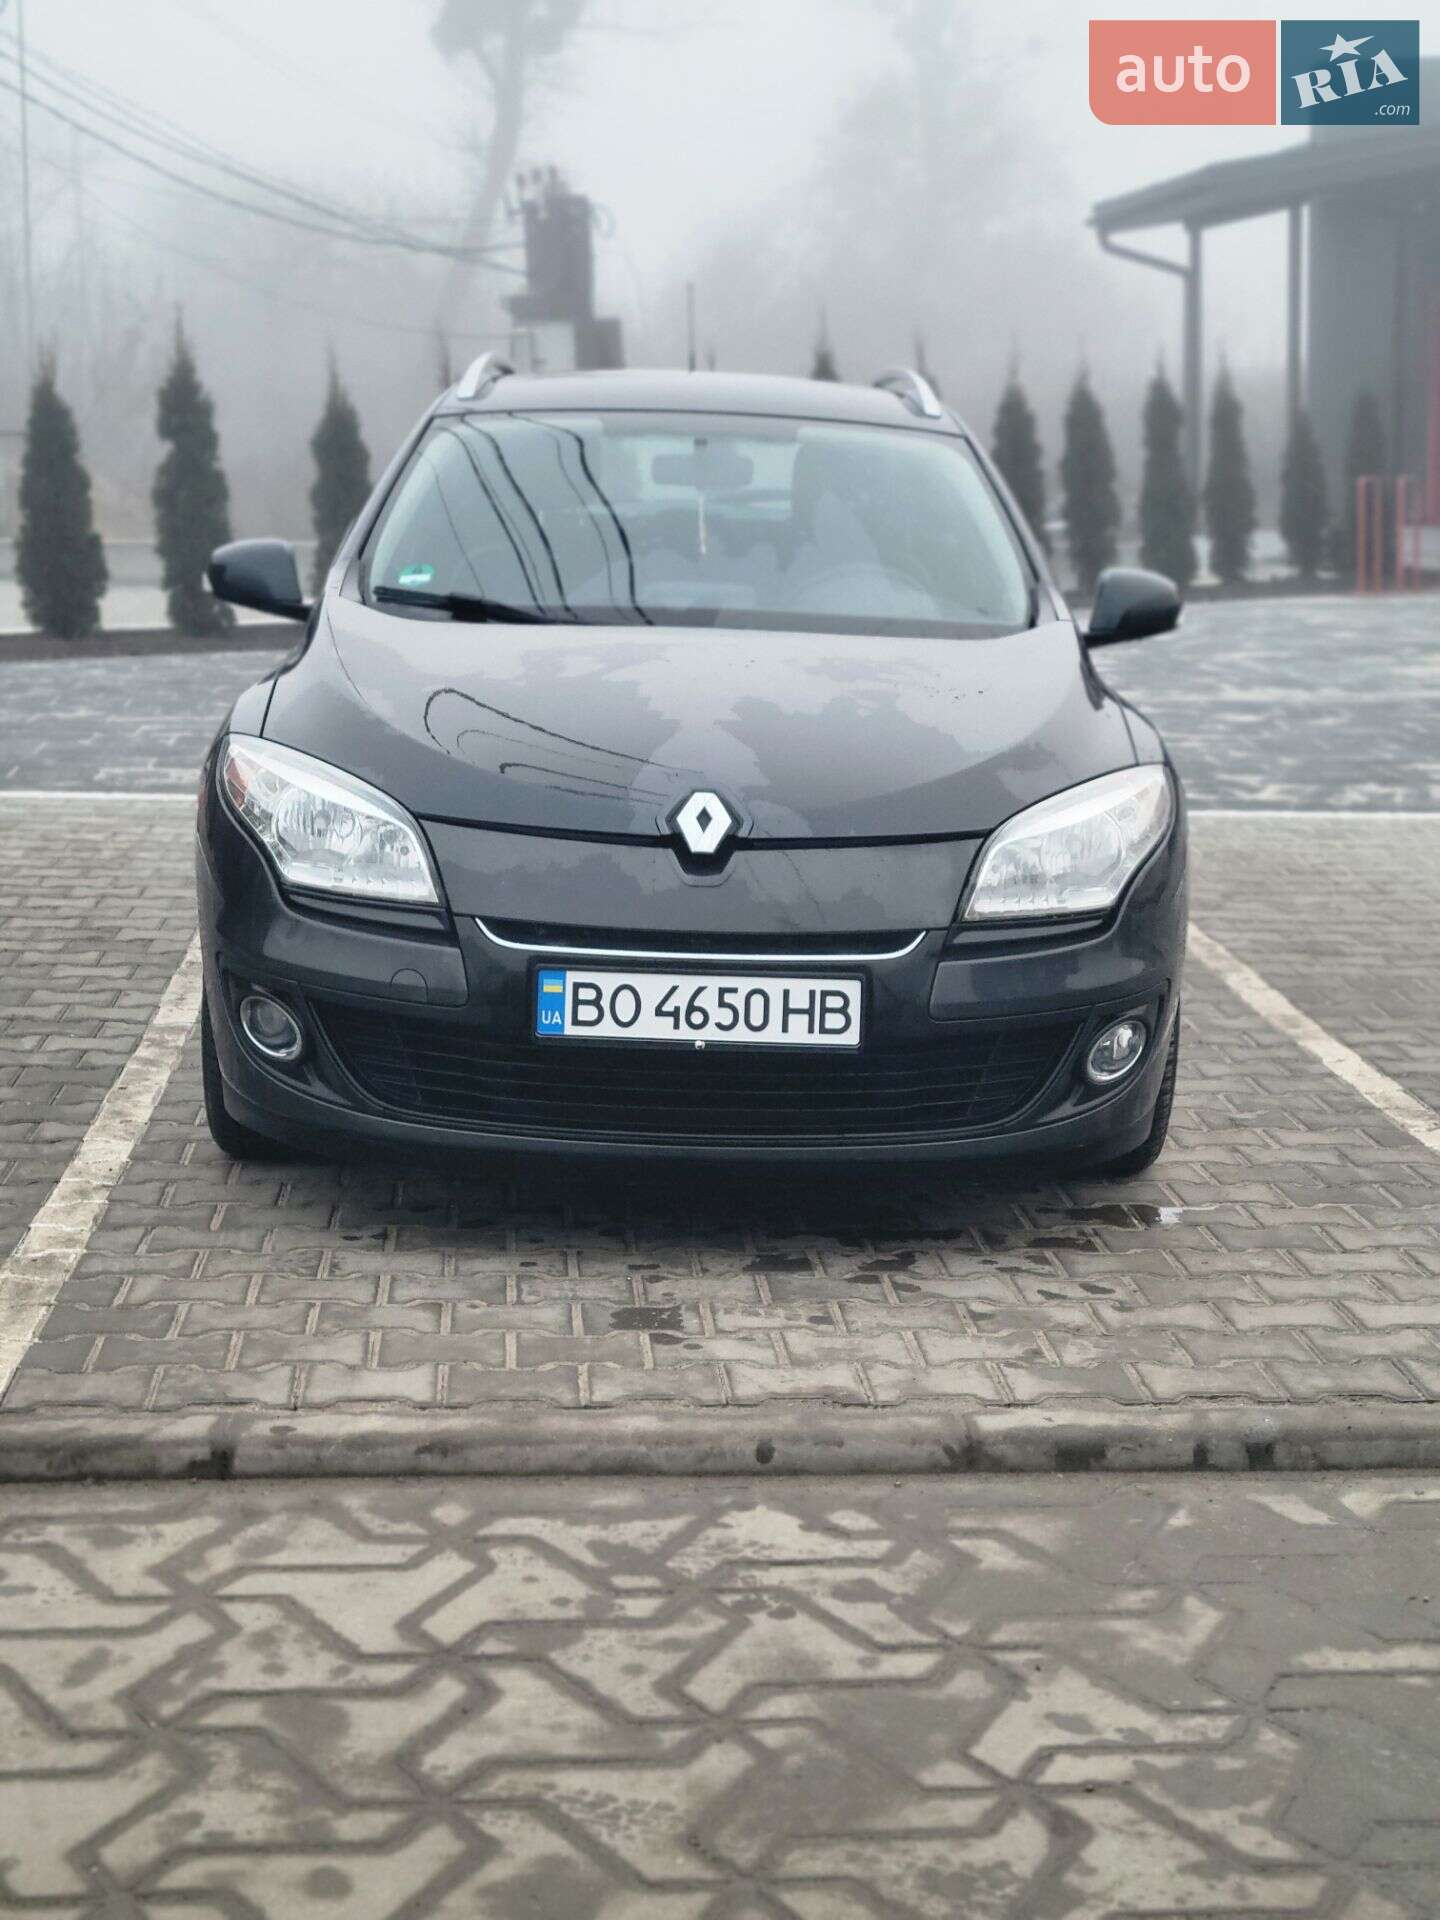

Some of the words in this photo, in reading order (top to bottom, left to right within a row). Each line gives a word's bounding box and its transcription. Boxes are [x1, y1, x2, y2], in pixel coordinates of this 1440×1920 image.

[541, 1010, 562, 1025] UA
[571, 981, 642, 1028] BO
[654, 984, 770, 1032] 4650
[781, 989, 852, 1035] HB
